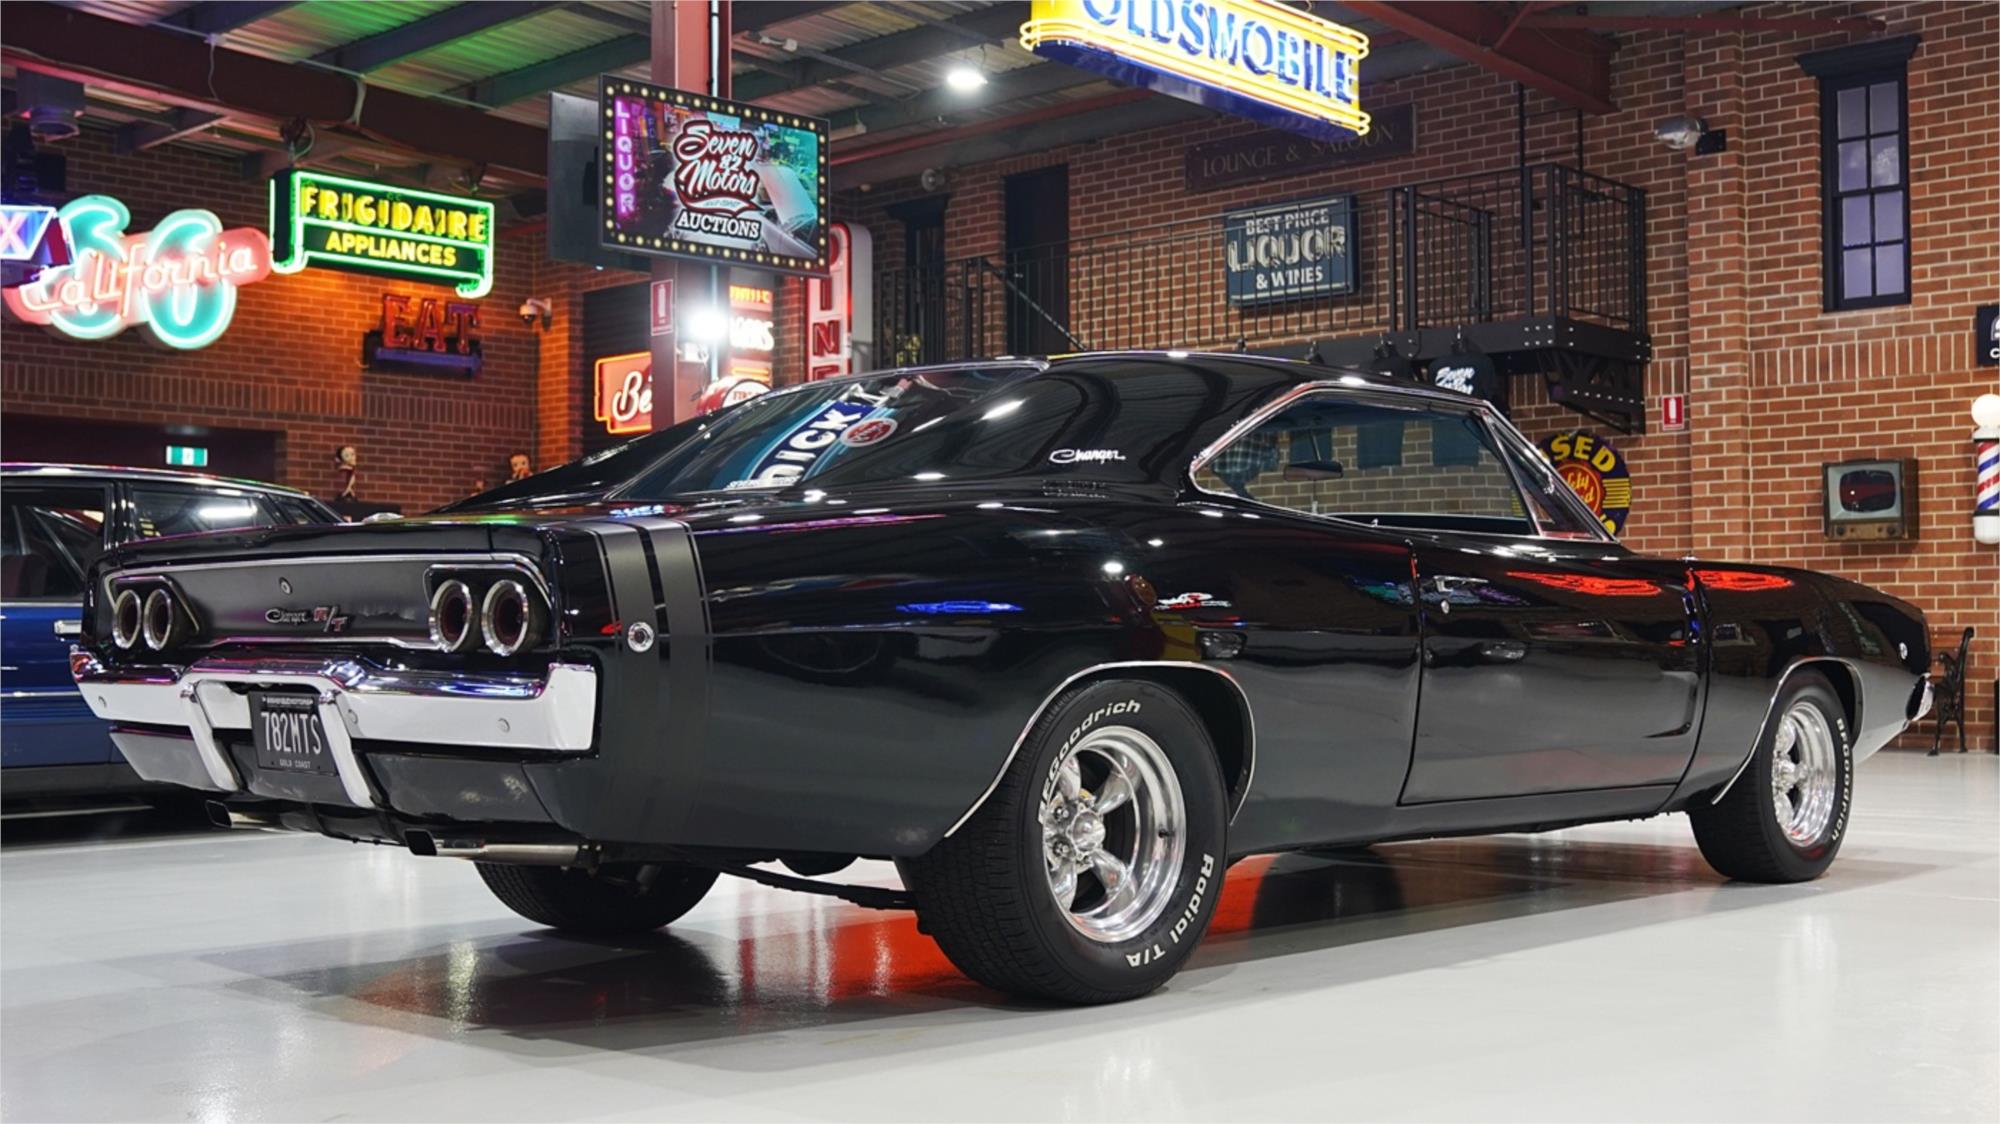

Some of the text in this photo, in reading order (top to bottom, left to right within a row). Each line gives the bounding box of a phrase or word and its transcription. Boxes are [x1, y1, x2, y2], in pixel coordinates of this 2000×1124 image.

[615, 100, 634, 213] LIQUOR
[677, 124, 755, 161] Seven
[1203, 144, 1278, 177] LOUNGE
[1286, 143, 1300, 162] &
[678, 159, 757, 196] Motors
[300, 185, 487, 242] FRIGIDAIRE
[676, 210, 760, 239] AUCTIONS
[1245, 208, 1330, 236] BEST PRICE
[325, 231, 457, 267] APPLIANCES
[1227, 225, 1346, 273] LIQUOR
[19, 241, 259, 319] California
[1256, 265, 1324, 290] & WINES
[383, 294, 481, 353] EAT
[1049, 448, 1127, 465] Charger
[313, 606, 348, 633] R/T
[260, 711, 322, 755] 782MTS
[1831, 717, 1852, 842] BFGoodrich
[1125, 853, 1215, 968] Radial T/A
